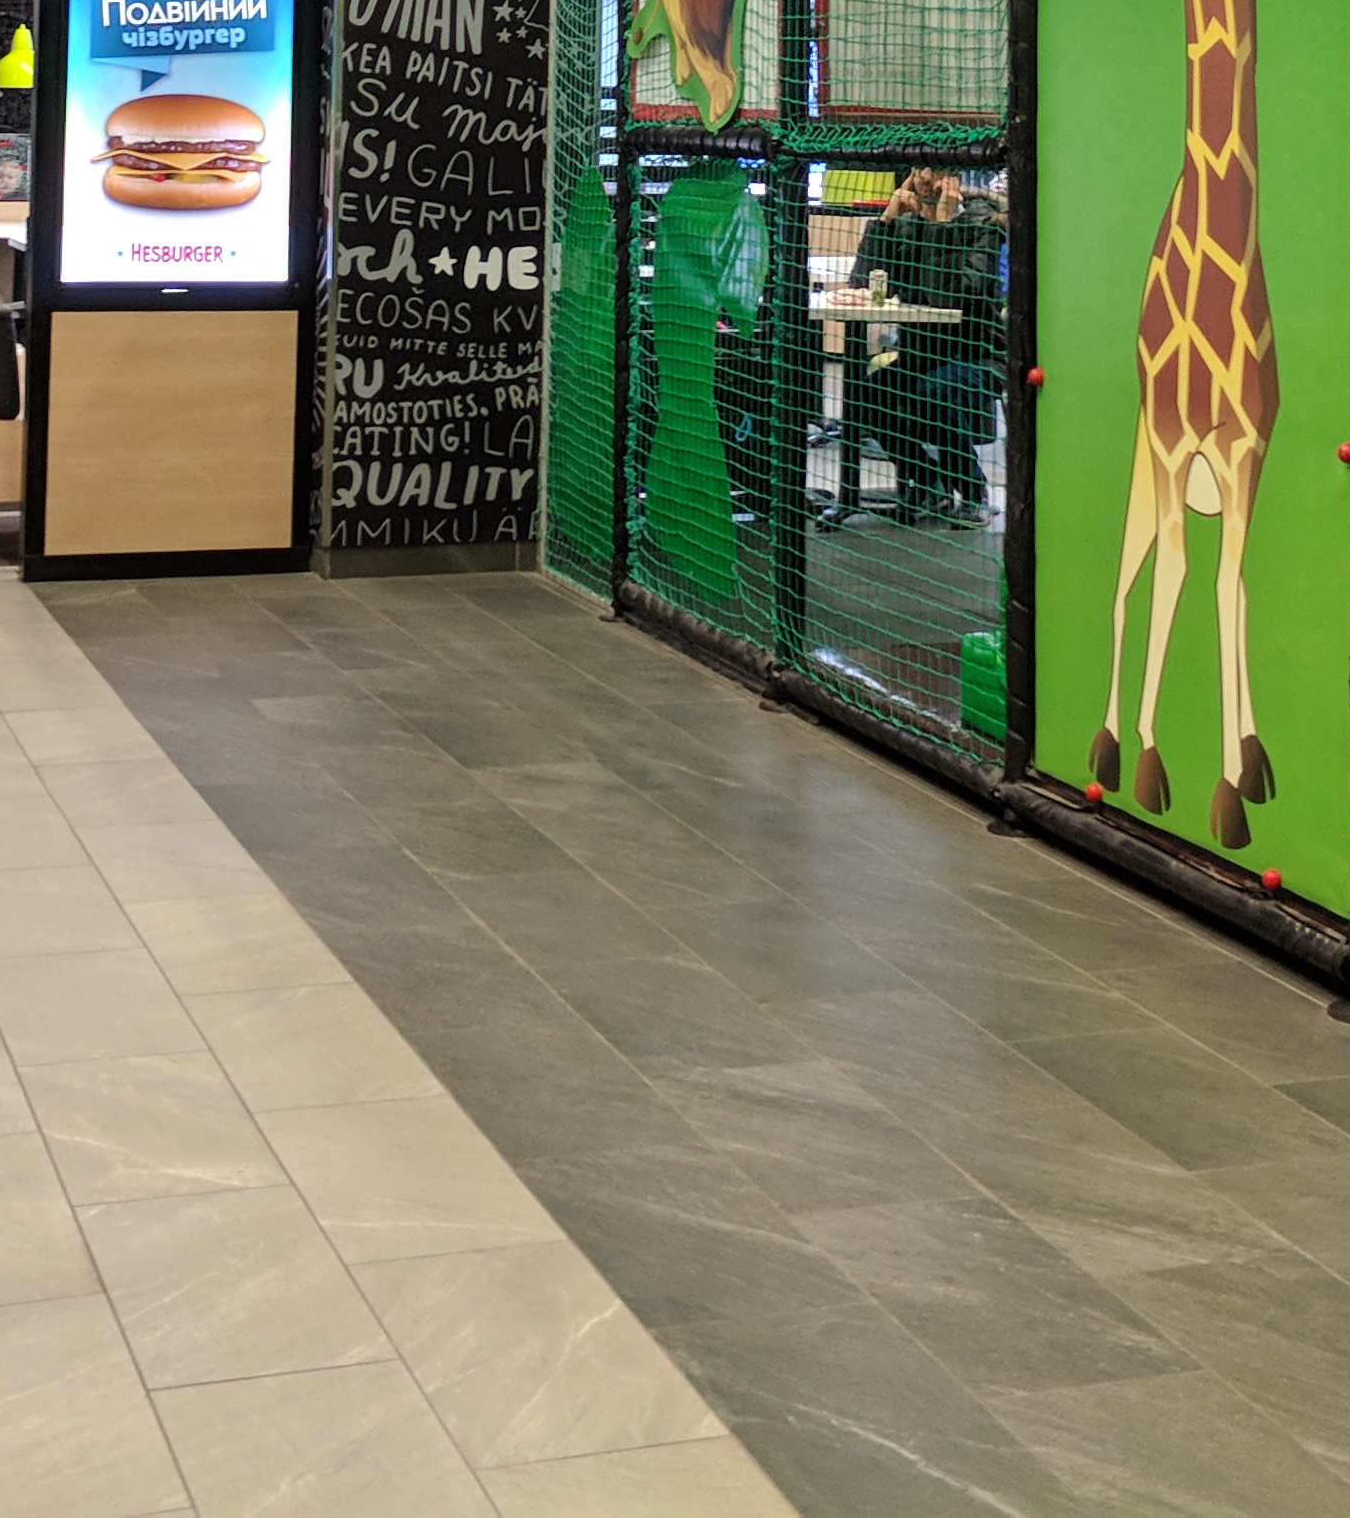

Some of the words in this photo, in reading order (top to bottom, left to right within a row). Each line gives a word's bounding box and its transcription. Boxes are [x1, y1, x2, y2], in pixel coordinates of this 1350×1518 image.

[122, 26, 246, 51] чізбургер
[406, 50, 493, 100] PAITSI
[351, 78, 420, 130] Su
[338, 192, 472, 233] EVERY
[131, 243, 223, 263] HESBURGER
[464, 245, 539, 292] HE
[389, 337, 448, 355] MITTE
[456, 342, 508, 358] SELLE
[484, 414, 535, 461] LA
[331, 459, 535, 509] QUALITY
